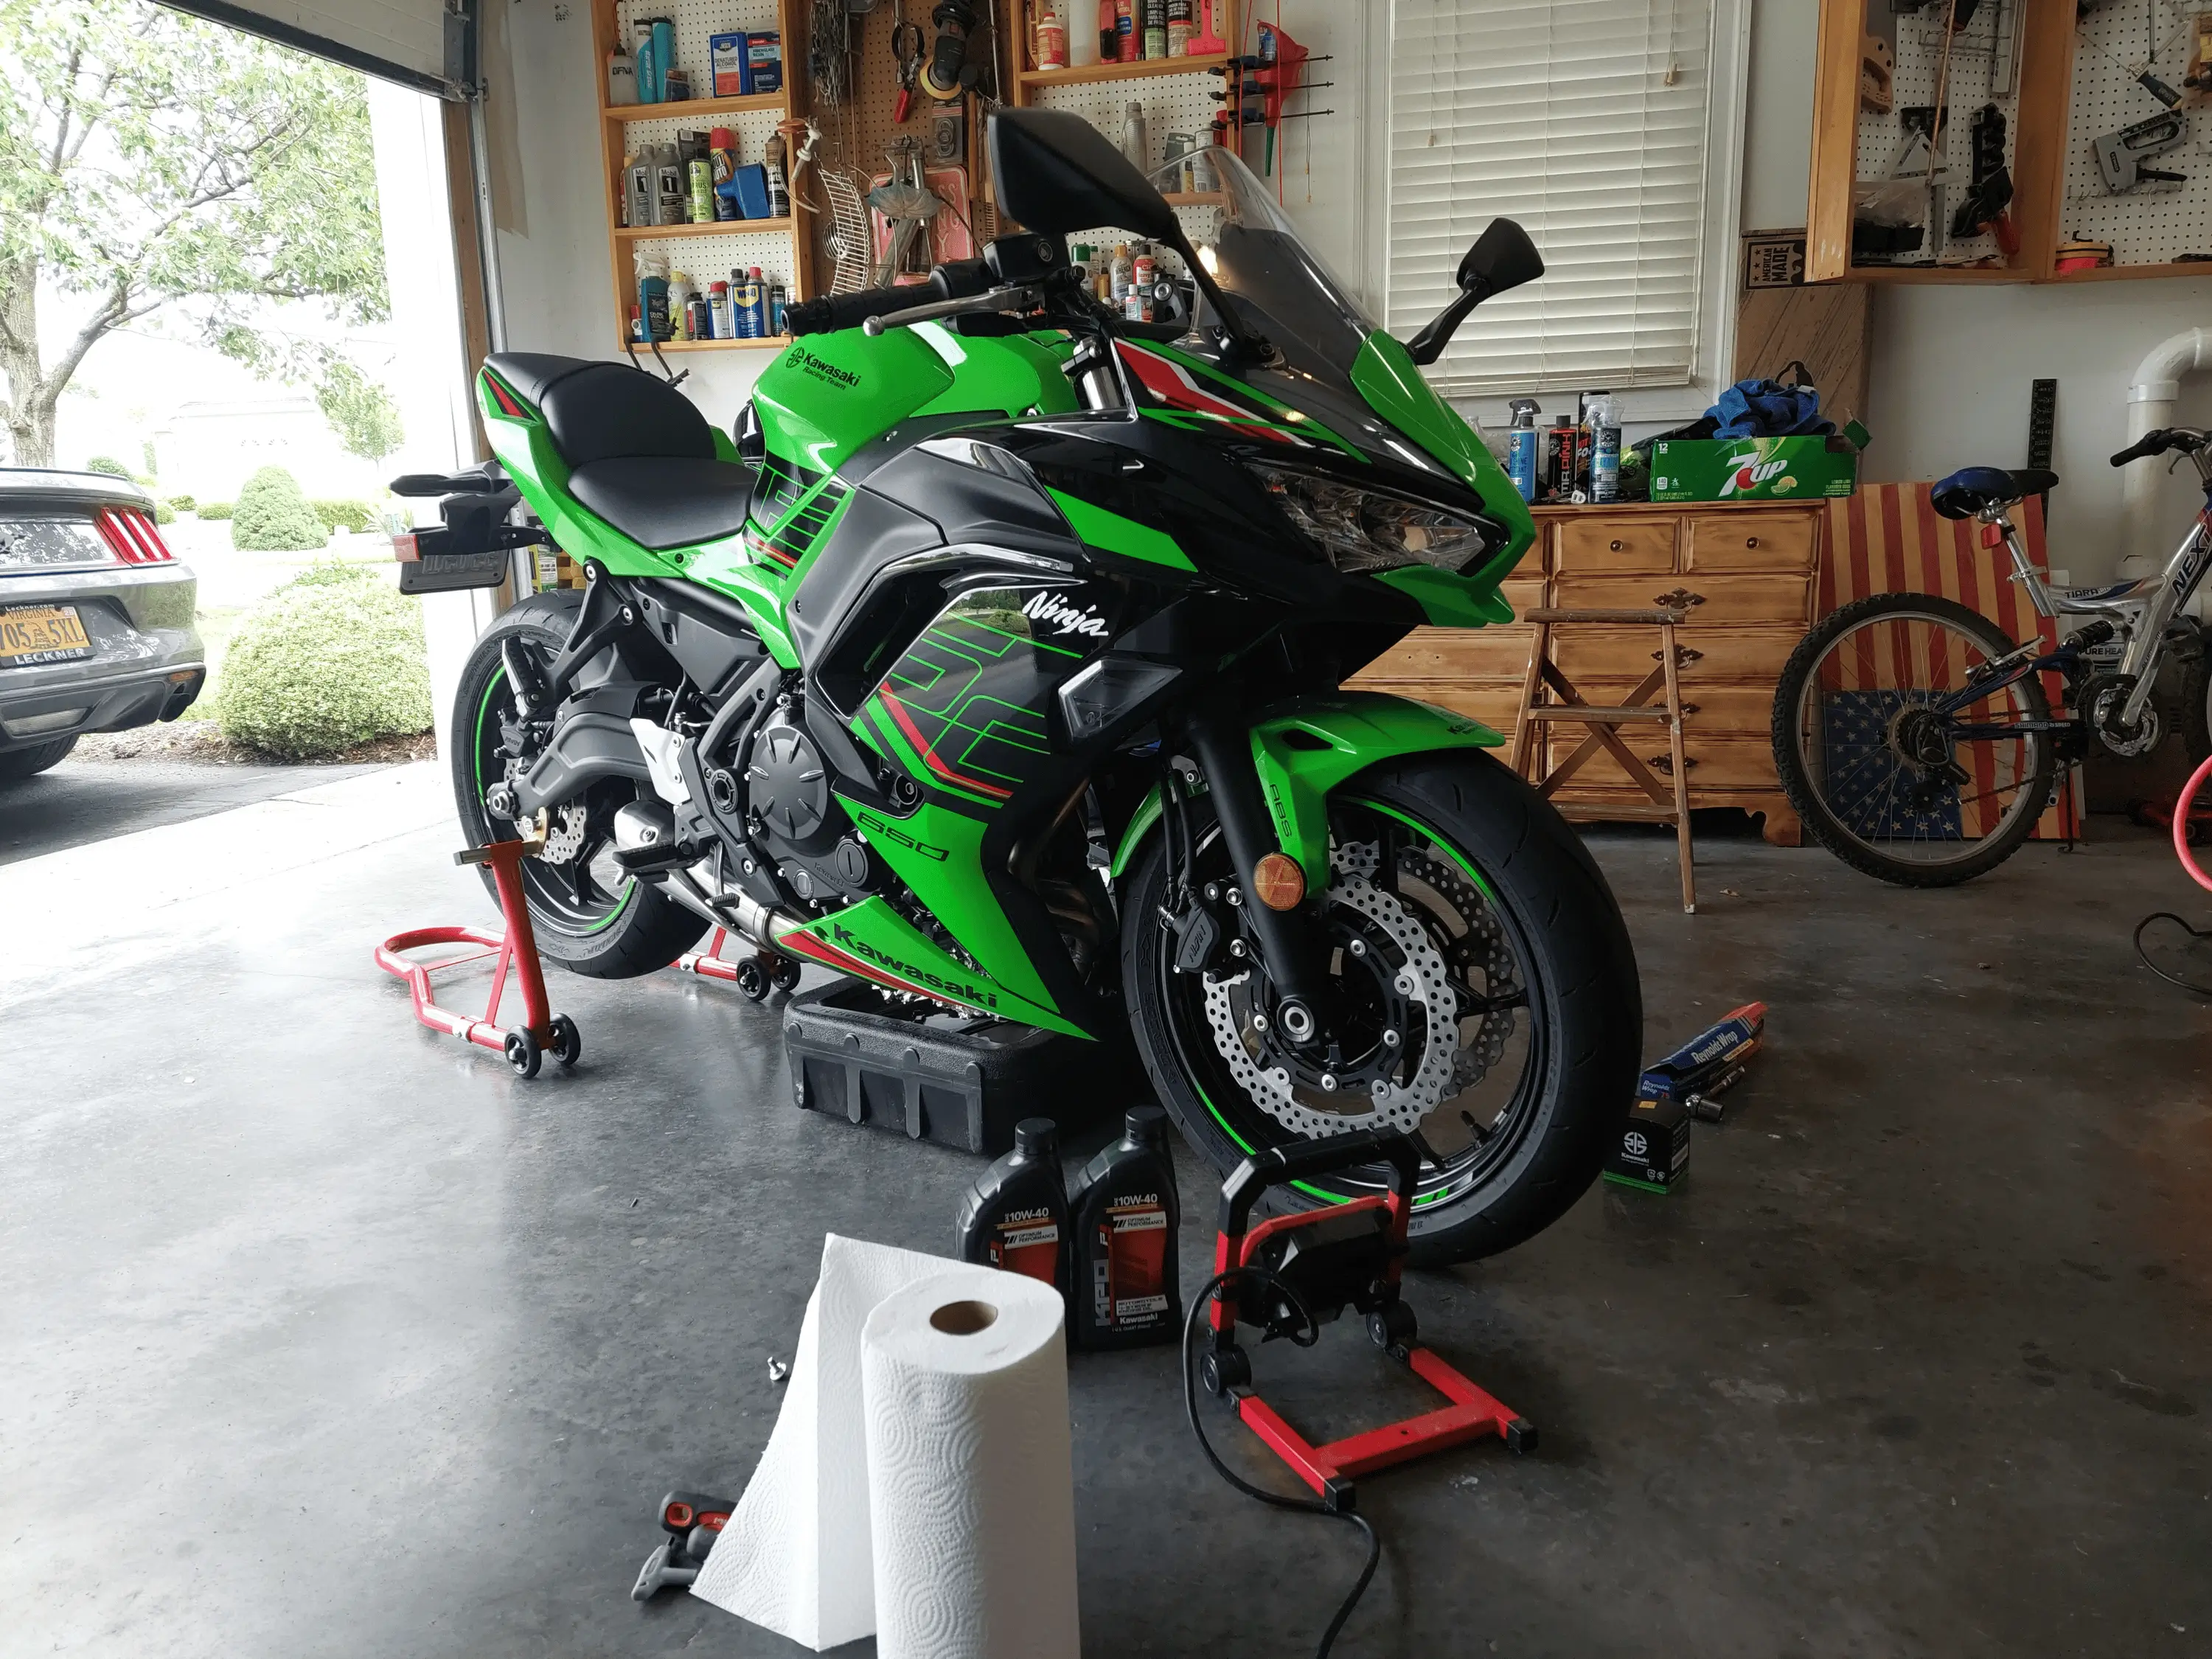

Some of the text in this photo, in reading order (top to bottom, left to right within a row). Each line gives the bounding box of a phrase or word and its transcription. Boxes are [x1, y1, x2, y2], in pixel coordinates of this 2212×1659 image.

[1772, 246, 1790, 282] MADE
[803, 352, 862, 387] Kawasaki
[802, 365, 846, 390] Racing Team
[1658, 443, 1669, 451] 12
[2065, 588, 2098, 599] TIARA
[7, 608, 56, 620] VIRGINIA
[1022, 591, 1109, 636] Ninja
[46, 618, 85, 644] 5XL
[14, 647, 86, 665] LECKNER
[2079, 647, 2104, 655] PURE
[1270, 784, 1293, 838] ABS
[858, 813, 950, 862] 650
[834, 922, 998, 1007] Kawasaki
[1691, 1040, 1723, 1065] Reynolds
[1642, 1085, 1658, 1094] Wrap
[1644, 1079, 1670, 1091] Reynolds
[1621, 1152, 1649, 1164] Kawasaki
[1119, 1193, 1158, 1206] 10W-40
[1009, 1206, 1049, 1222] 10W-40
[1127, 1219, 1164, 1228] PERFORMANCE
[1018, 1233, 1056, 1244] PERFORMANCE
[1119, 1312, 1159, 1325] Kawasaki
